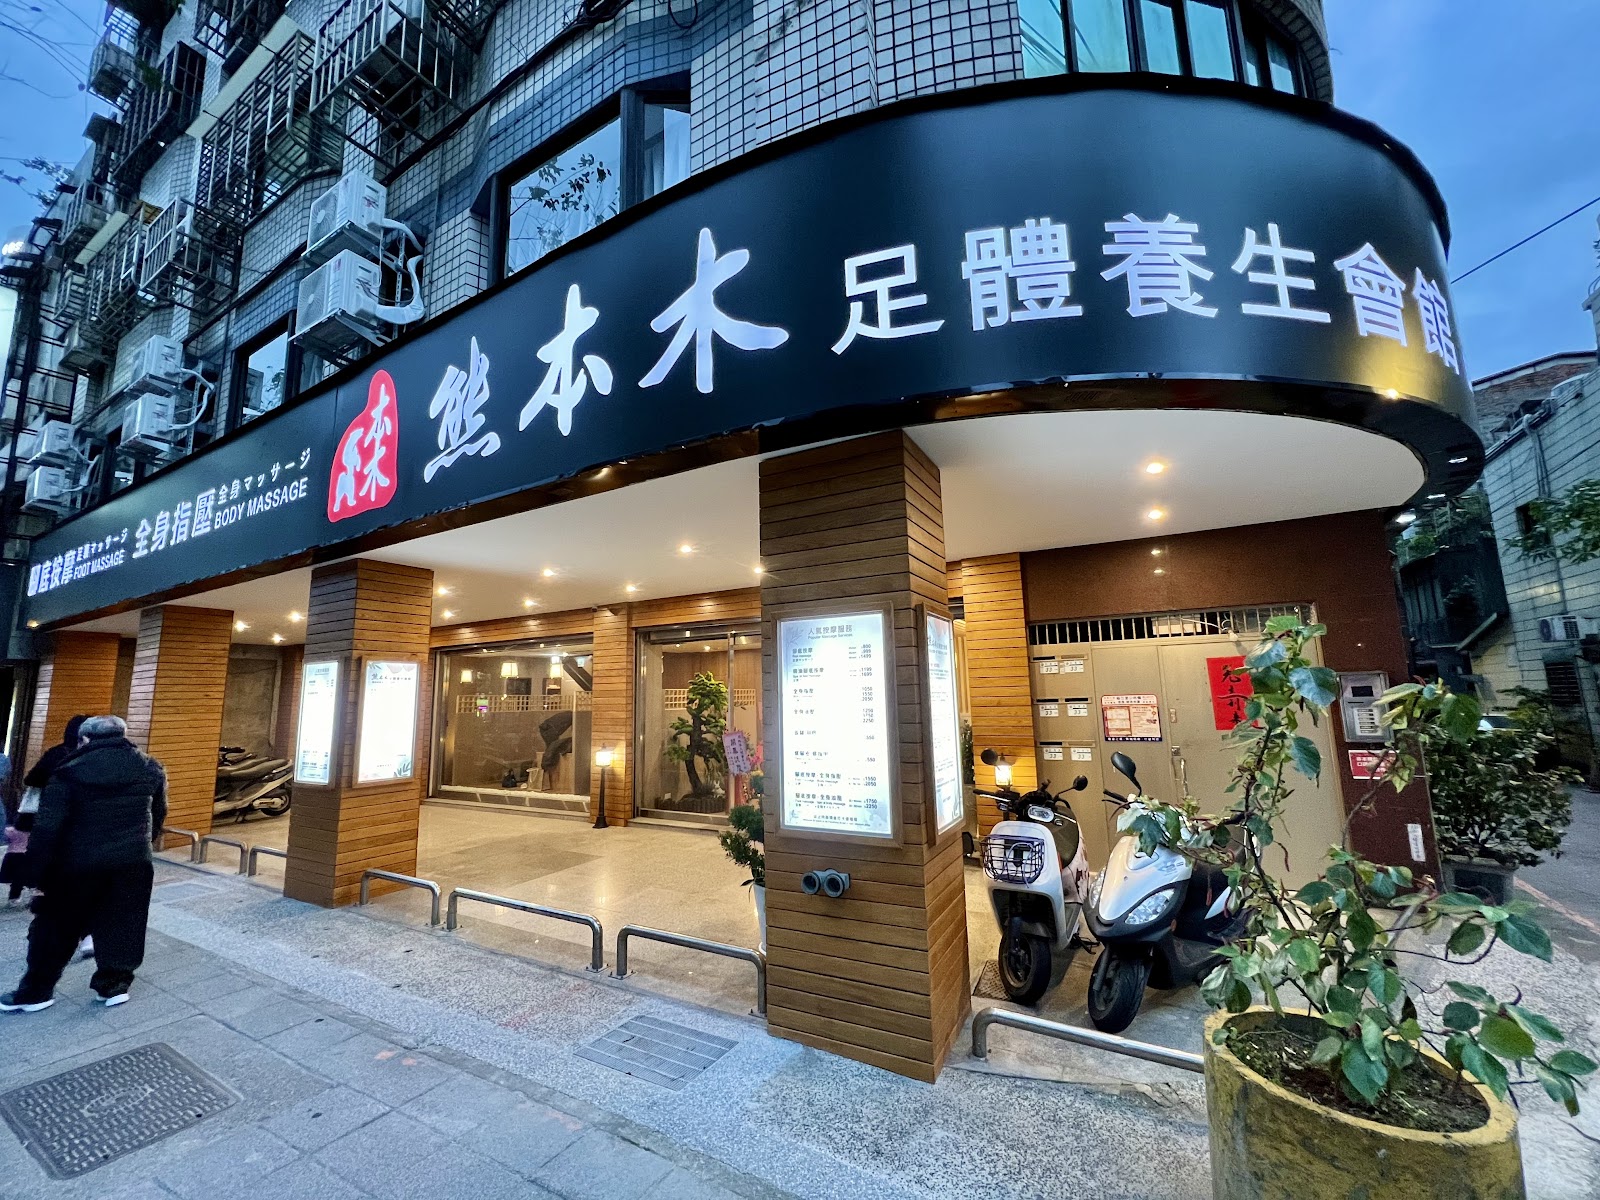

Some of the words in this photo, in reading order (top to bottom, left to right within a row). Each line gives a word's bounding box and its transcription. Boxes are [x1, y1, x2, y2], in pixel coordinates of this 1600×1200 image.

[424, 228, 790, 484] 熊本木
[831, 212, 1462, 377] 足體養生會館
[214, 501, 245, 529] BODY
[246, 477, 309, 517] MASSAGE
[218, 447, 311, 504] 全身マッサージ
[132, 488, 218, 559] 全身指壓
[73, 562, 91, 580] FOOT
[90, 549, 126, 573] MASSAGE
